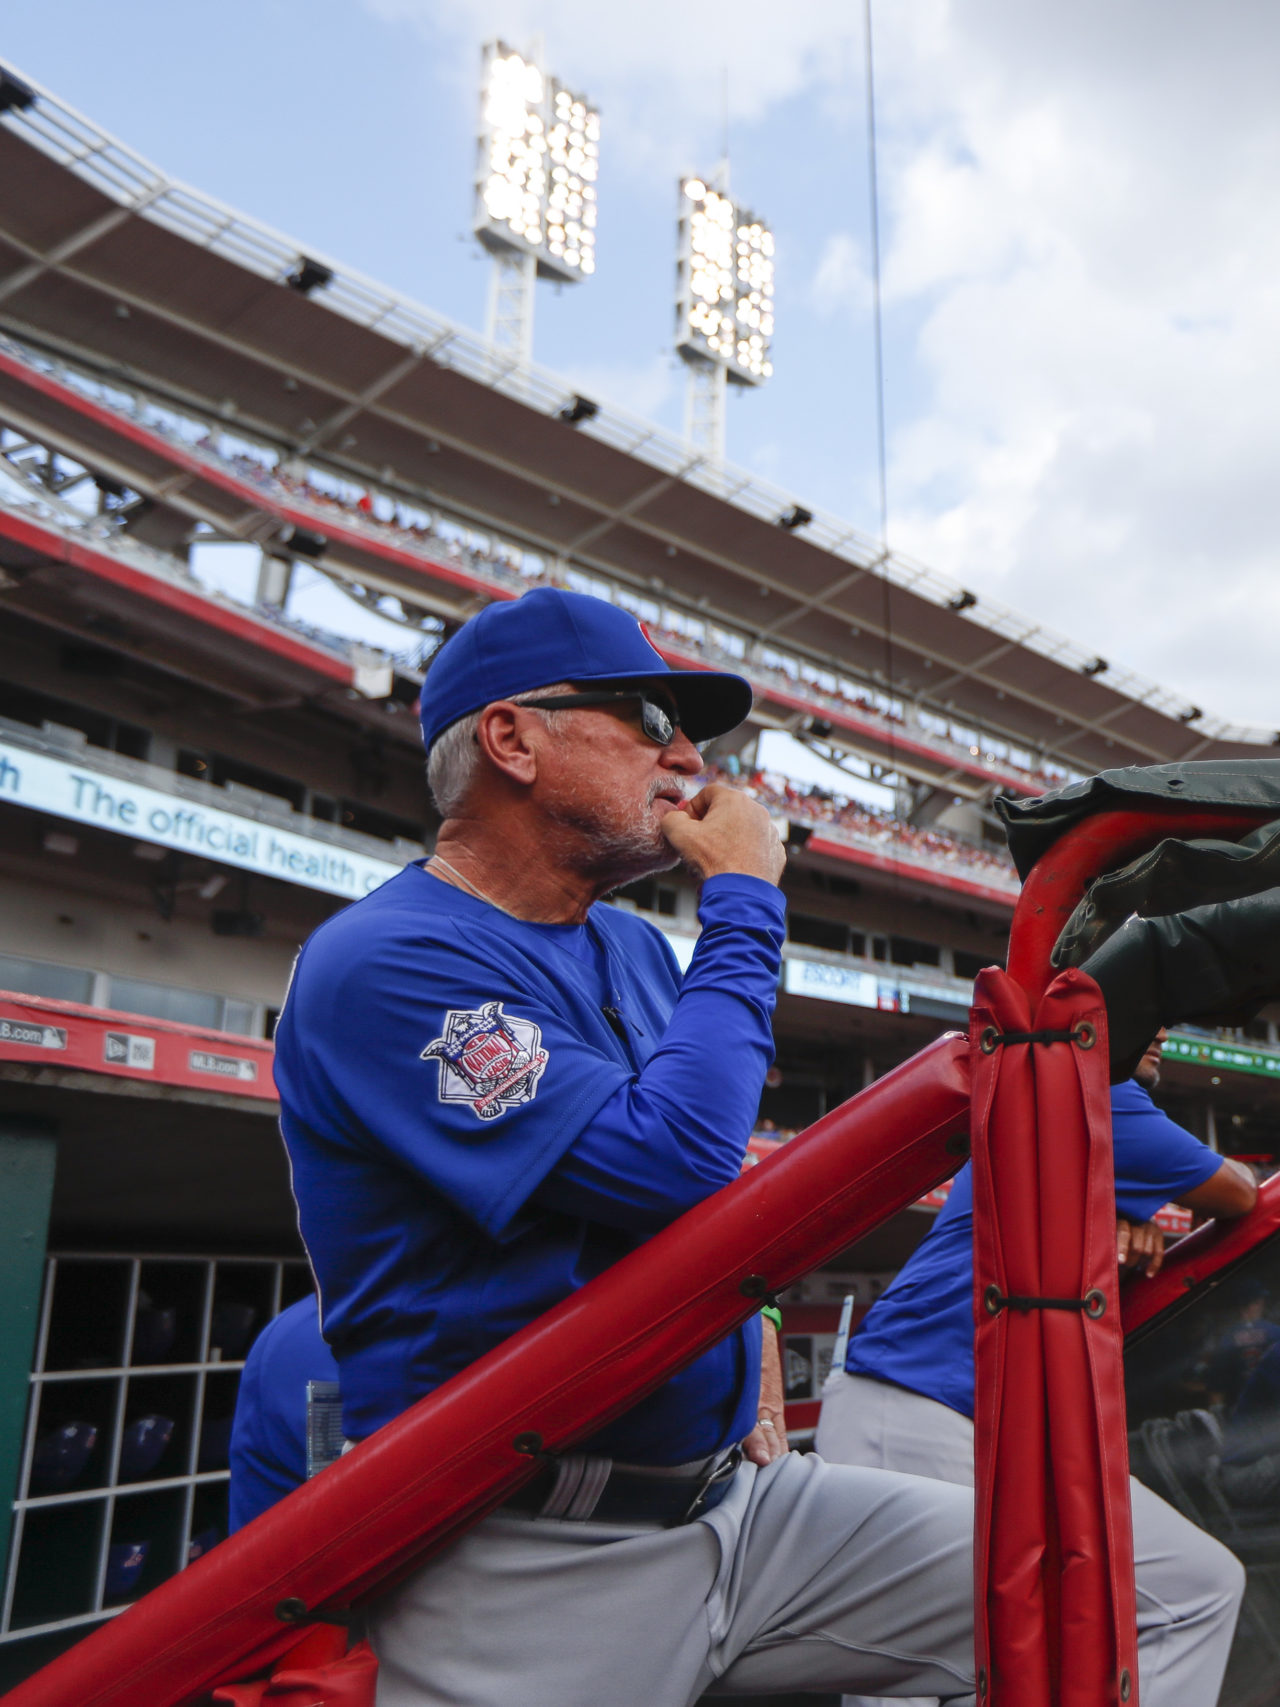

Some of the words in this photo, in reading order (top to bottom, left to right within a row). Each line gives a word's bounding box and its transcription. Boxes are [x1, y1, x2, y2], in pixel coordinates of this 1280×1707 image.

[69, 774, 137, 824] The
[149, 808, 260, 858] official
[267, 837, 356, 887] health
[464, 1036, 511, 1075] NATIONAL
